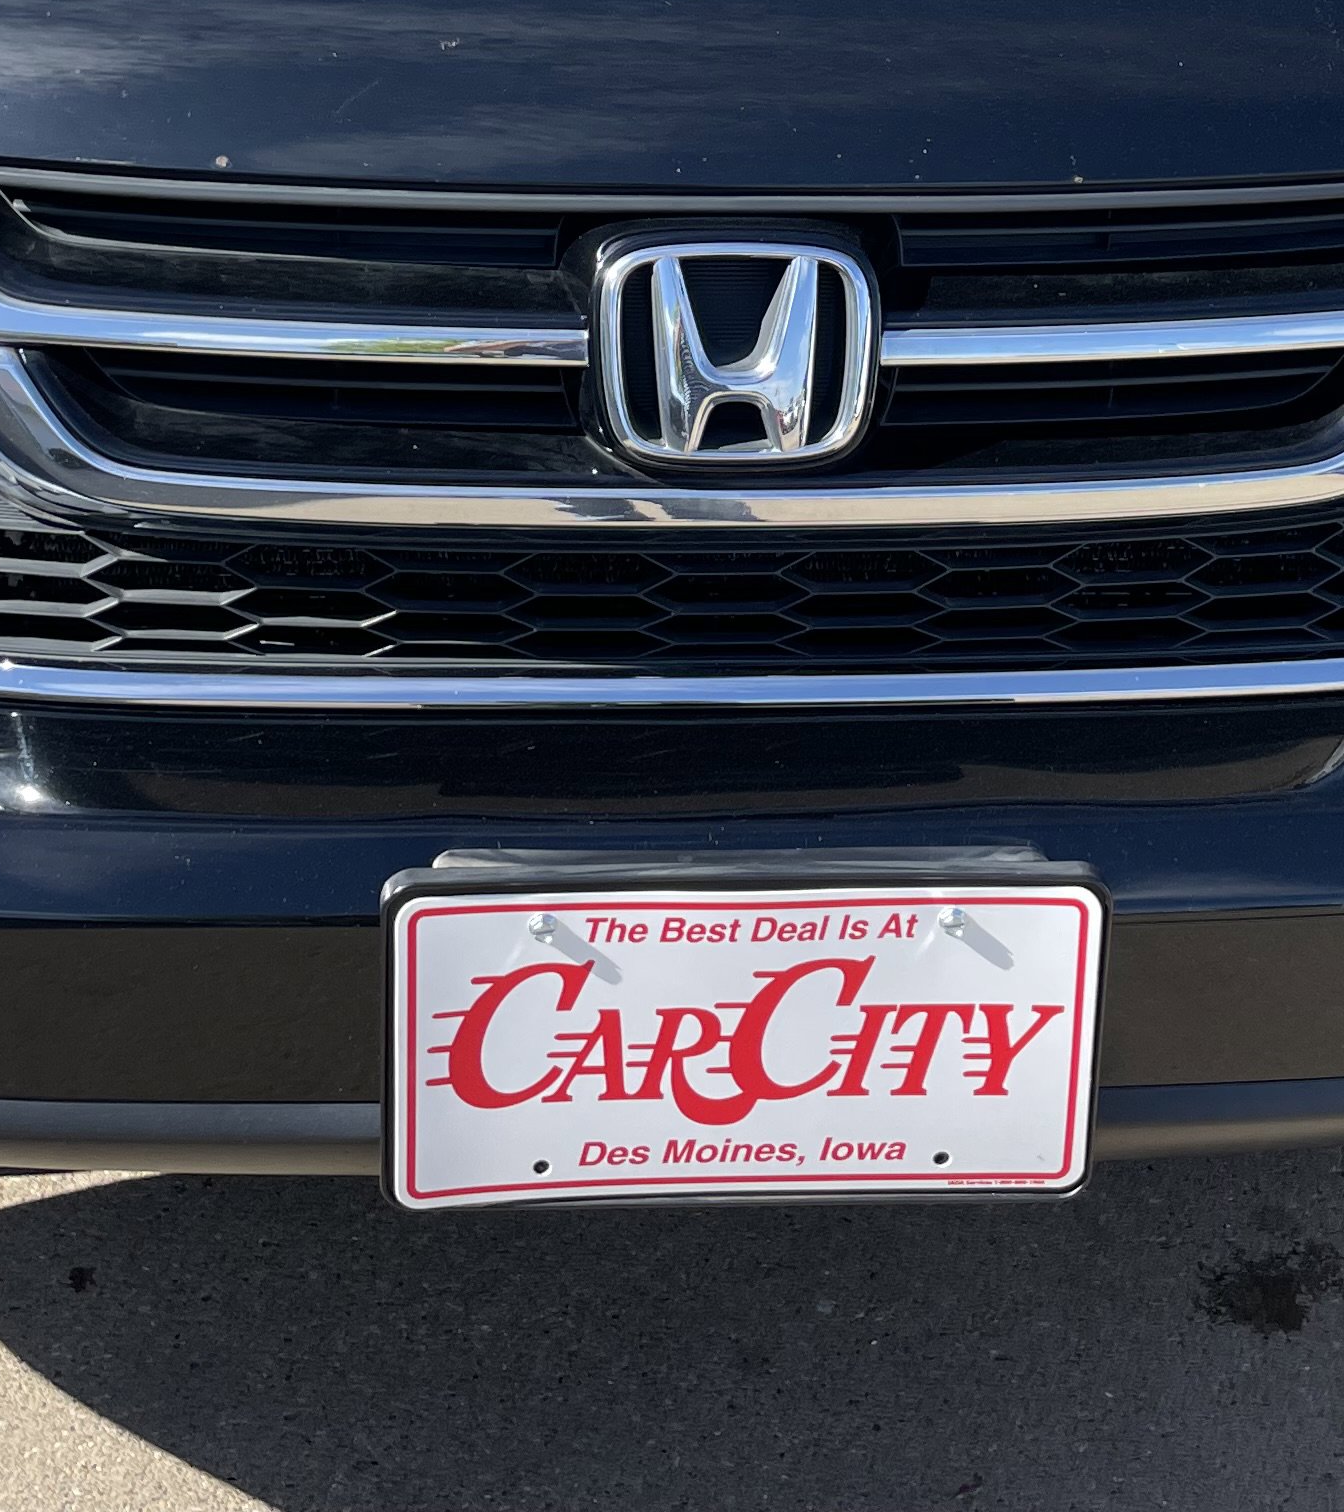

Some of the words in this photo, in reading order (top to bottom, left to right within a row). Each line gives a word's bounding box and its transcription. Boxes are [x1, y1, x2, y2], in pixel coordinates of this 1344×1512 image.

[585, 917, 649, 944] The
[659, 916, 741, 944] Best
[750, 914, 830, 943] Deal
[838, 913, 870, 941] Is
[878, 912, 919, 939] At
[578, 1140, 650, 1167] Des
[661, 1137, 806, 1167] Moines,
[819, 1137, 907, 1163] Iowa
